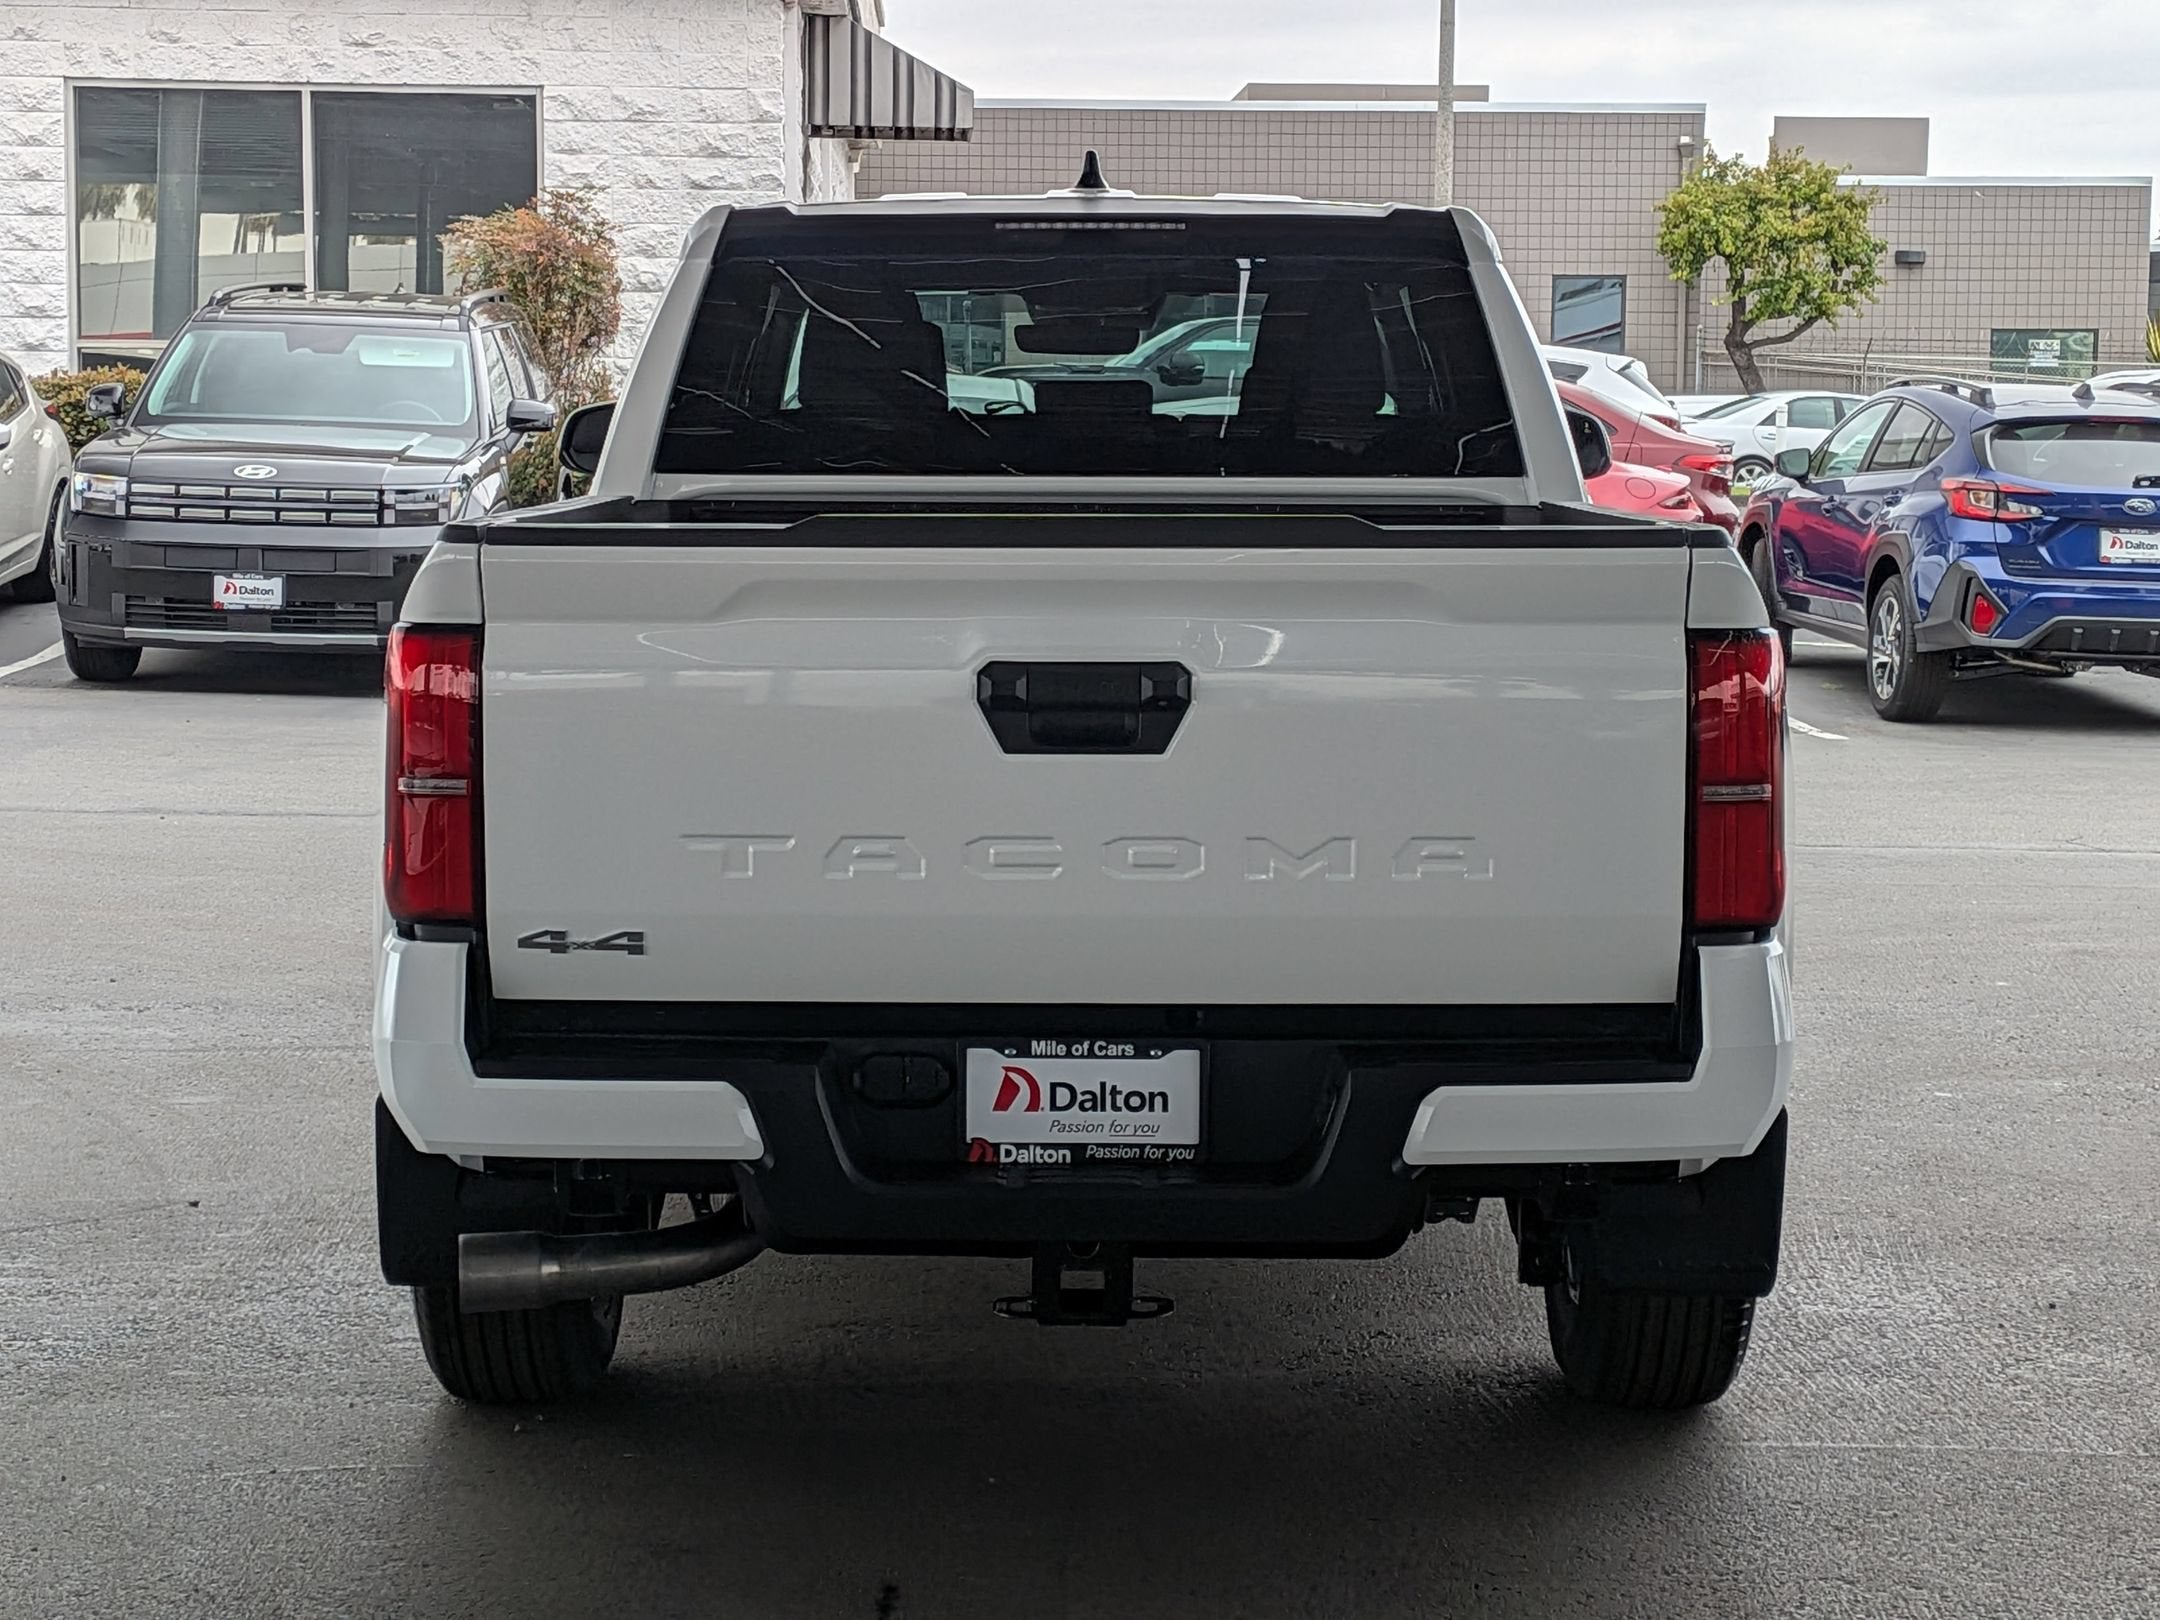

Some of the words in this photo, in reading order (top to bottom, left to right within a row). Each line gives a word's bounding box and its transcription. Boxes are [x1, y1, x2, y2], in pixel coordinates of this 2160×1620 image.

[2125, 540, 2159, 550] Dalton
[239, 585, 274, 596] Dalton
[679, 834, 1494, 880] TACOMA
[517, 929, 645, 955] 4x4
[1031, 1040, 1066, 1056] Mile
[1071, 1040, 1091, 1056] of
[1094, 1040, 1135, 1057] Cars
[1049, 1081, 1169, 1113] Dalton
[1049, 1119, 1104, 1134] Passion
[1109, 1120, 1129, 1135] for
[1132, 1123, 1160, 1135] you
[1000, 1144, 1072, 1164] Dalton
[1086, 1144, 1139, 1159] Passion
[1142, 1145, 1165, 1160] for
[1166, 1147, 1195, 1162] you
